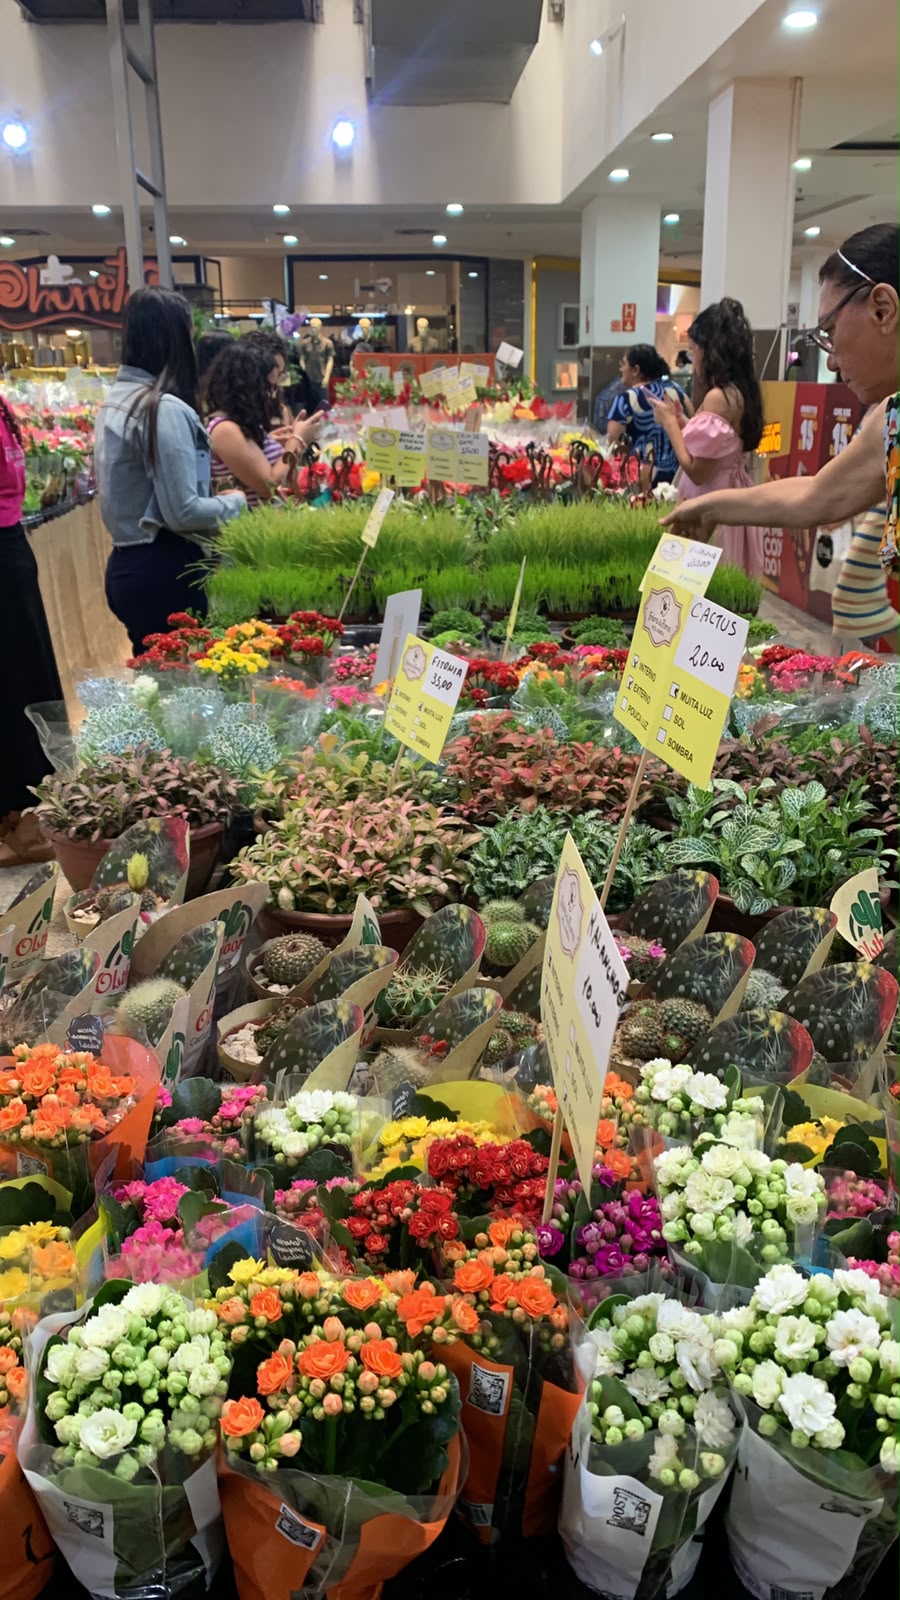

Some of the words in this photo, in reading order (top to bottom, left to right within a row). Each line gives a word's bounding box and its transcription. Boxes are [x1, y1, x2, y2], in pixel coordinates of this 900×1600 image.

[625, 304, 634, 317] H
[691, 602, 737, 636] CACTUS
[431, 656, 463, 678] FITONIA
[638, 662, 657, 682] INTERNO
[430, 673, 453, 690] 35,00
[632, 683, 651, 704] EXTERNO
[627, 705, 641, 722] POUCA
[680, 692, 699, 711] MUITA
[700, 704, 714, 720] LUZ
[673, 715, 686, 730] SOL
[667, 738, 694, 763] SOMBRA
